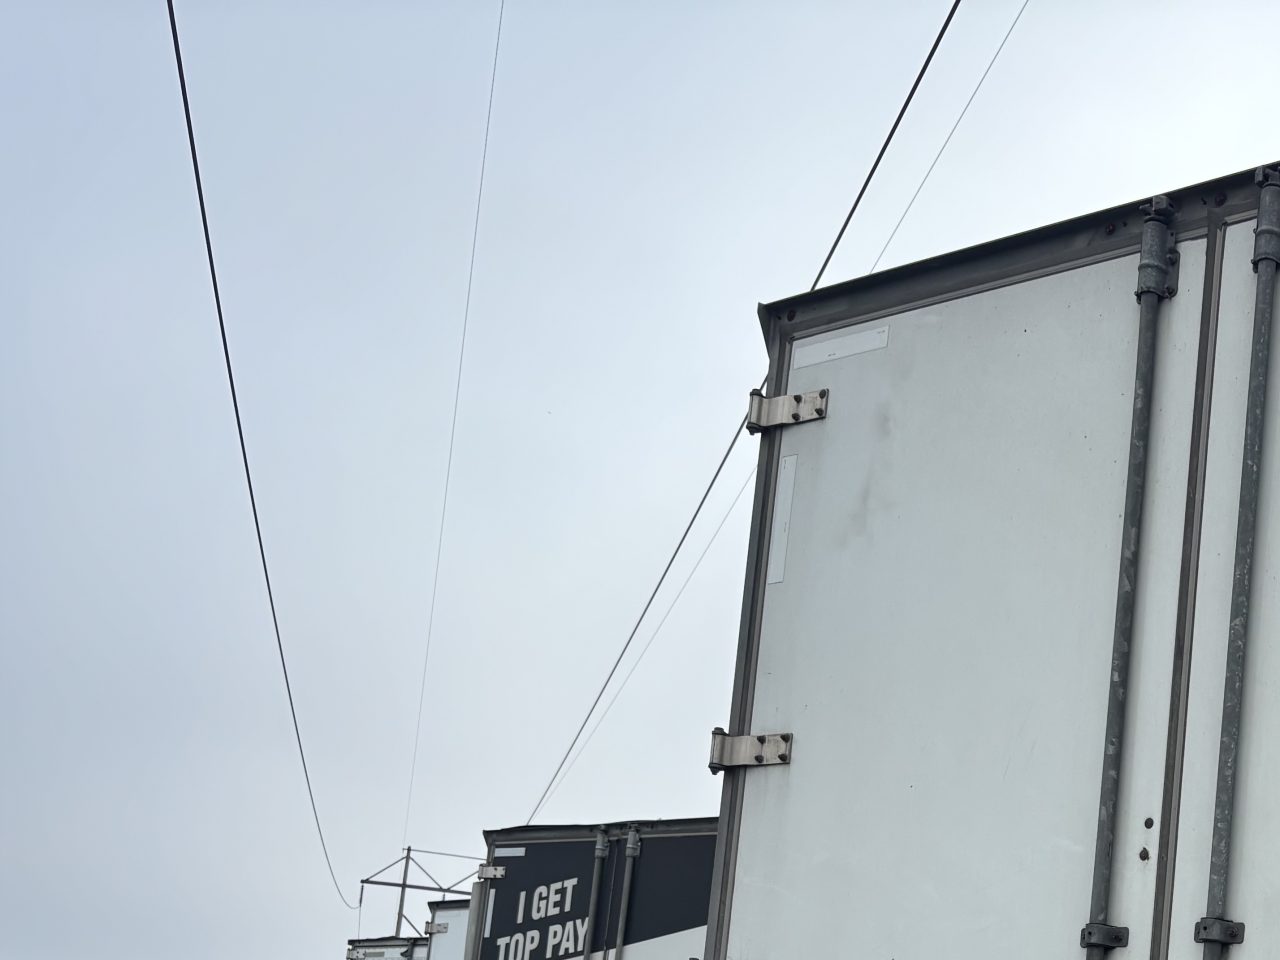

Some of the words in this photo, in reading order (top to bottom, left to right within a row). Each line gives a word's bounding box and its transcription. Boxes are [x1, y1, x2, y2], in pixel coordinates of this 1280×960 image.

[517, 890, 526, 924] I
[531, 877, 578, 920] GET
[545, 917, 589, 959] PAY
